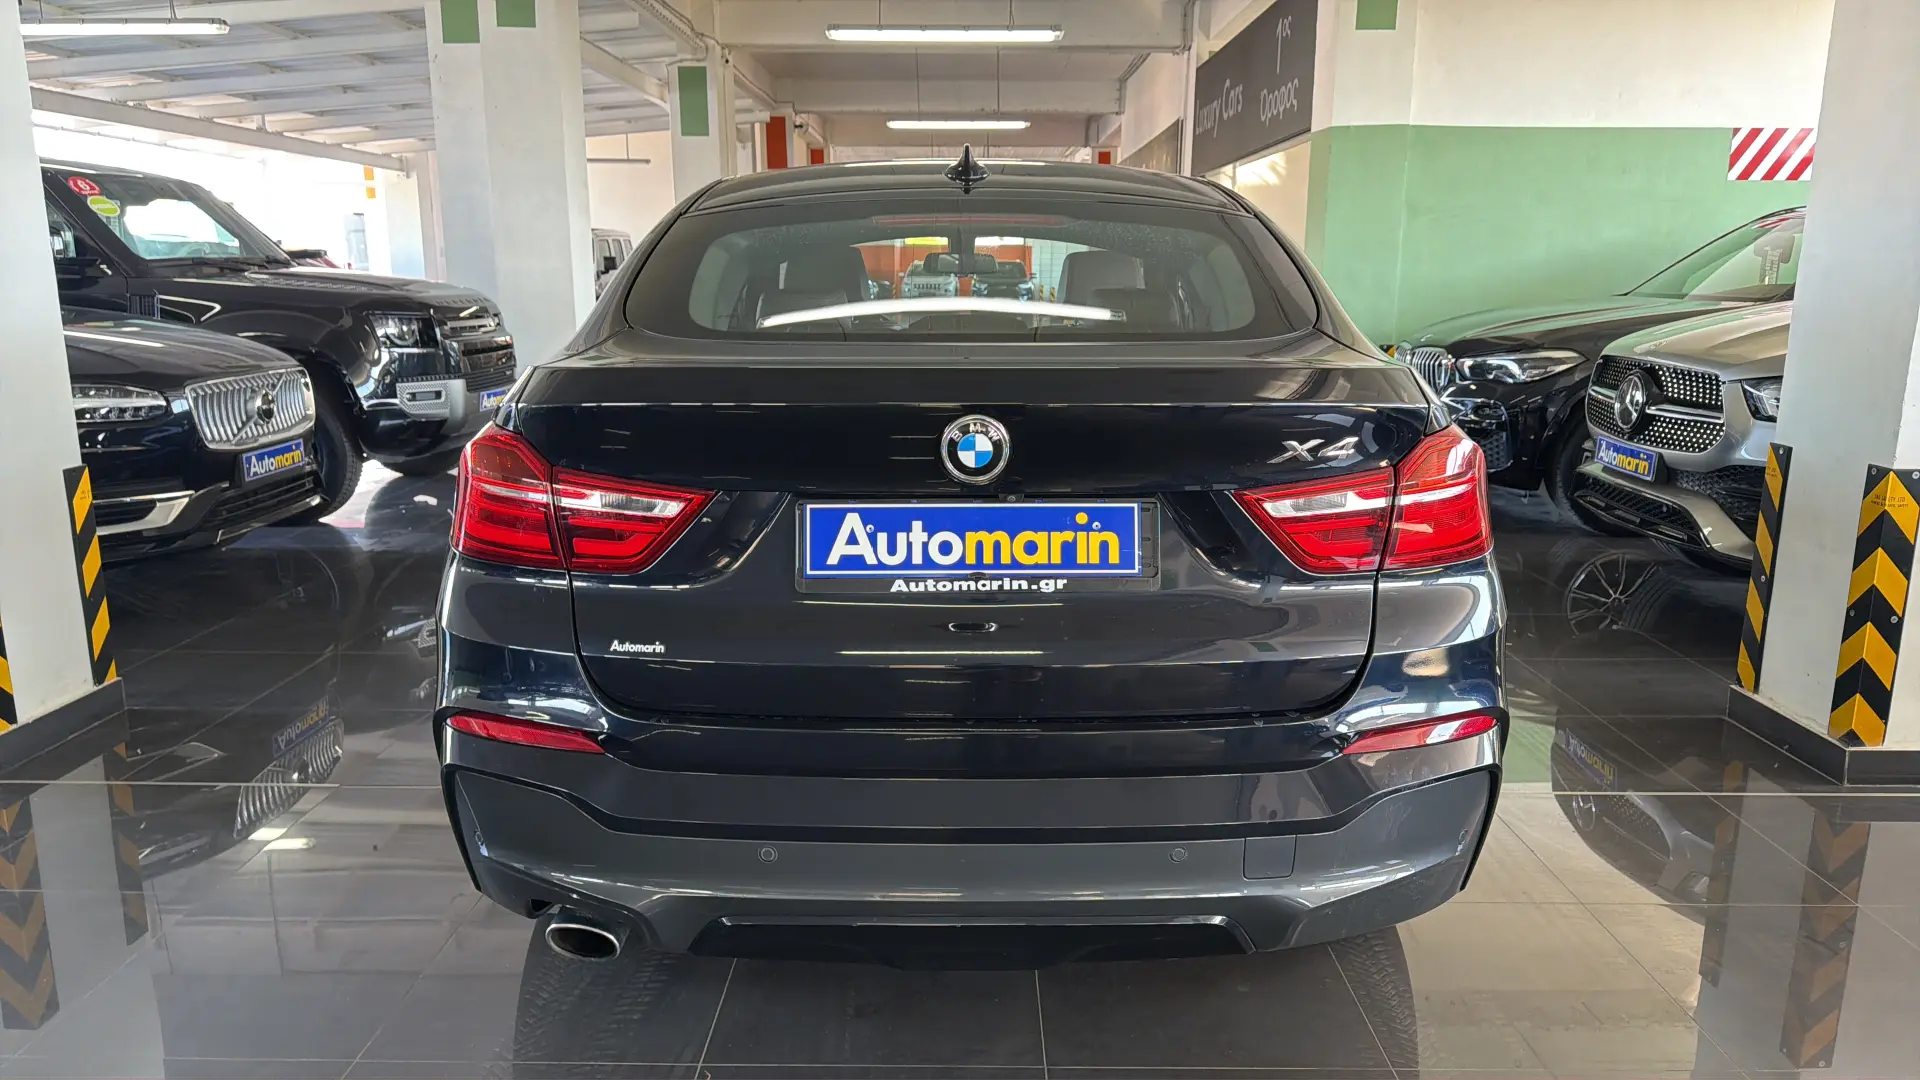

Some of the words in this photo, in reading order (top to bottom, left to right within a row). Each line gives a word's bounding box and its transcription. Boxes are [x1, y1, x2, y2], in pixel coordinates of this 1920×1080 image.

[1195, 97, 1222, 138] Luxury
[1222, 78, 1243, 120] Cars
[250, 444, 302, 477] Automarin
[1267, 436, 1359, 464] X4
[1598, 440, 1649, 476] Automarin
[825, 512, 1120, 566] Automarin
[889, 577, 1068, 593] Automarin.gr
[609, 639, 665, 654] Automarin
